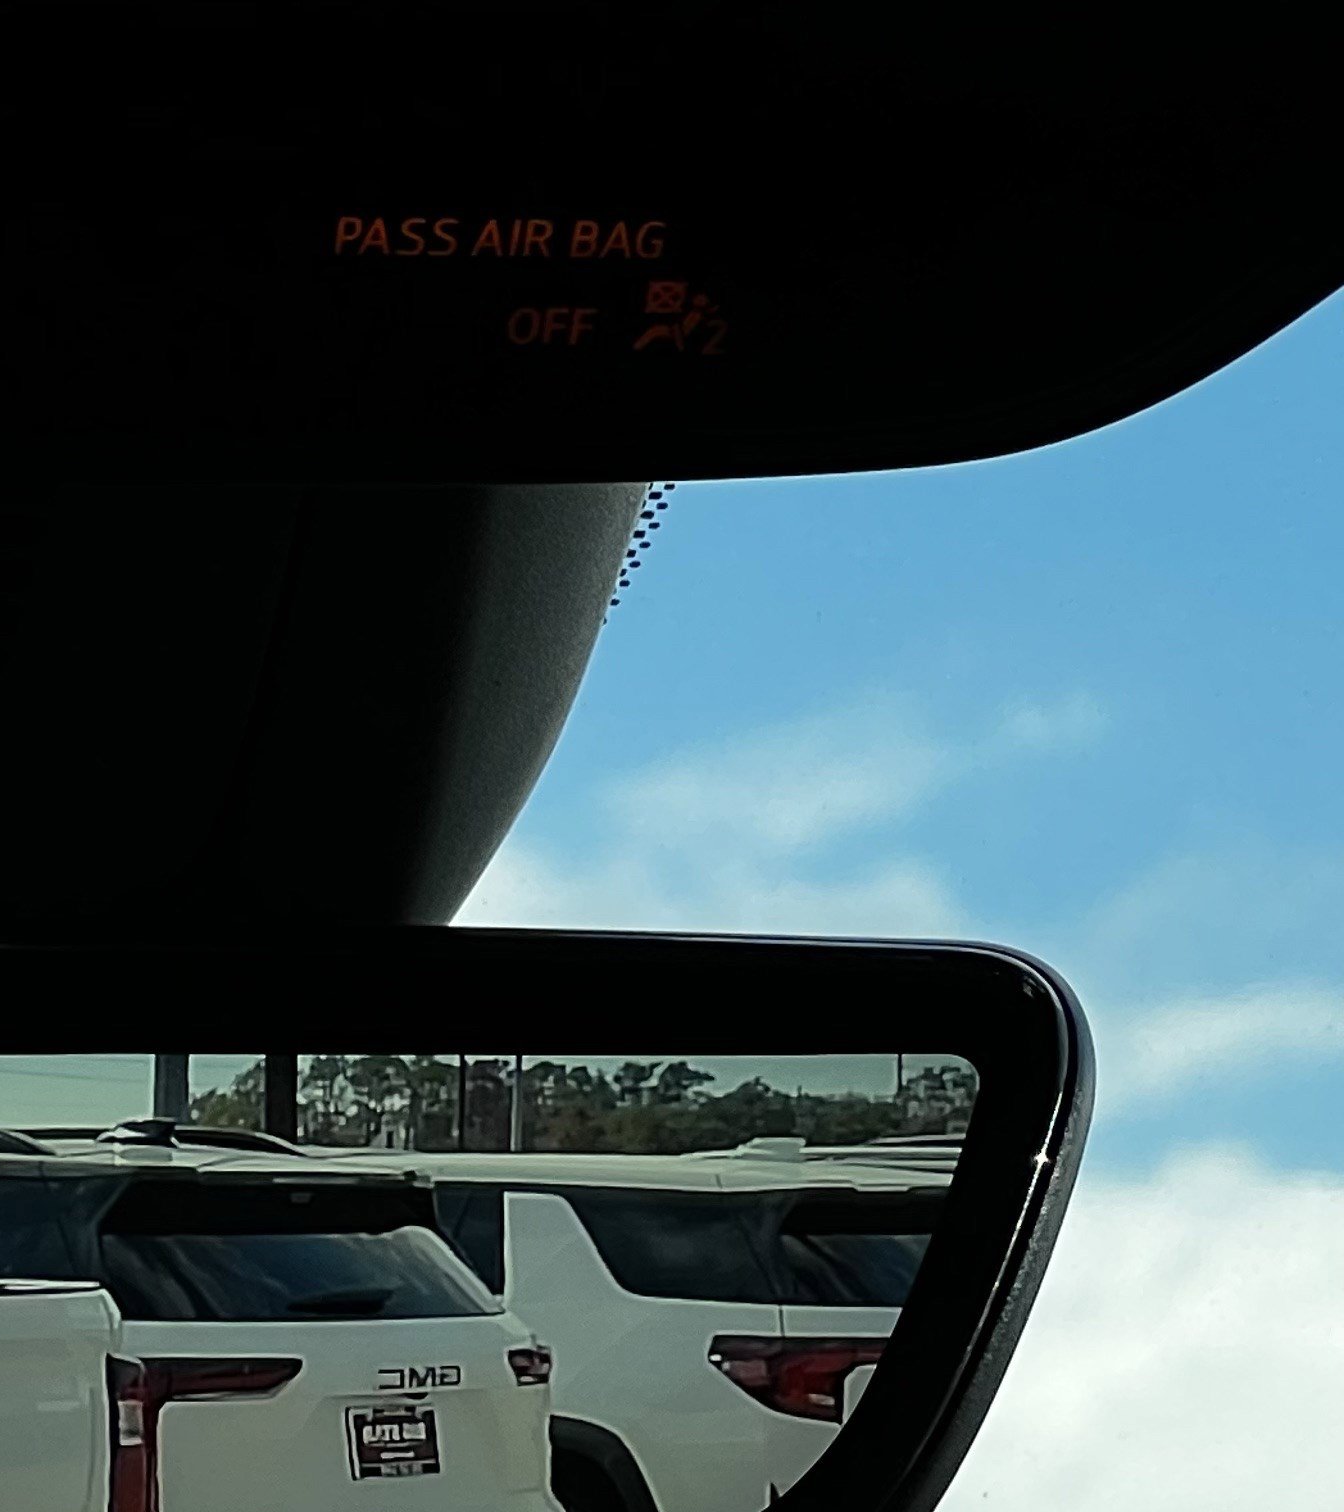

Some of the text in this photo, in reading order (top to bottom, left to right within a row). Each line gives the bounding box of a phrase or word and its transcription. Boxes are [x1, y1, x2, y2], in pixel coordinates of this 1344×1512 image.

[334, 216, 667, 259] PASS AIR BAG
[506, 307, 599, 346] OFF
[700, 319, 728, 356] 2
